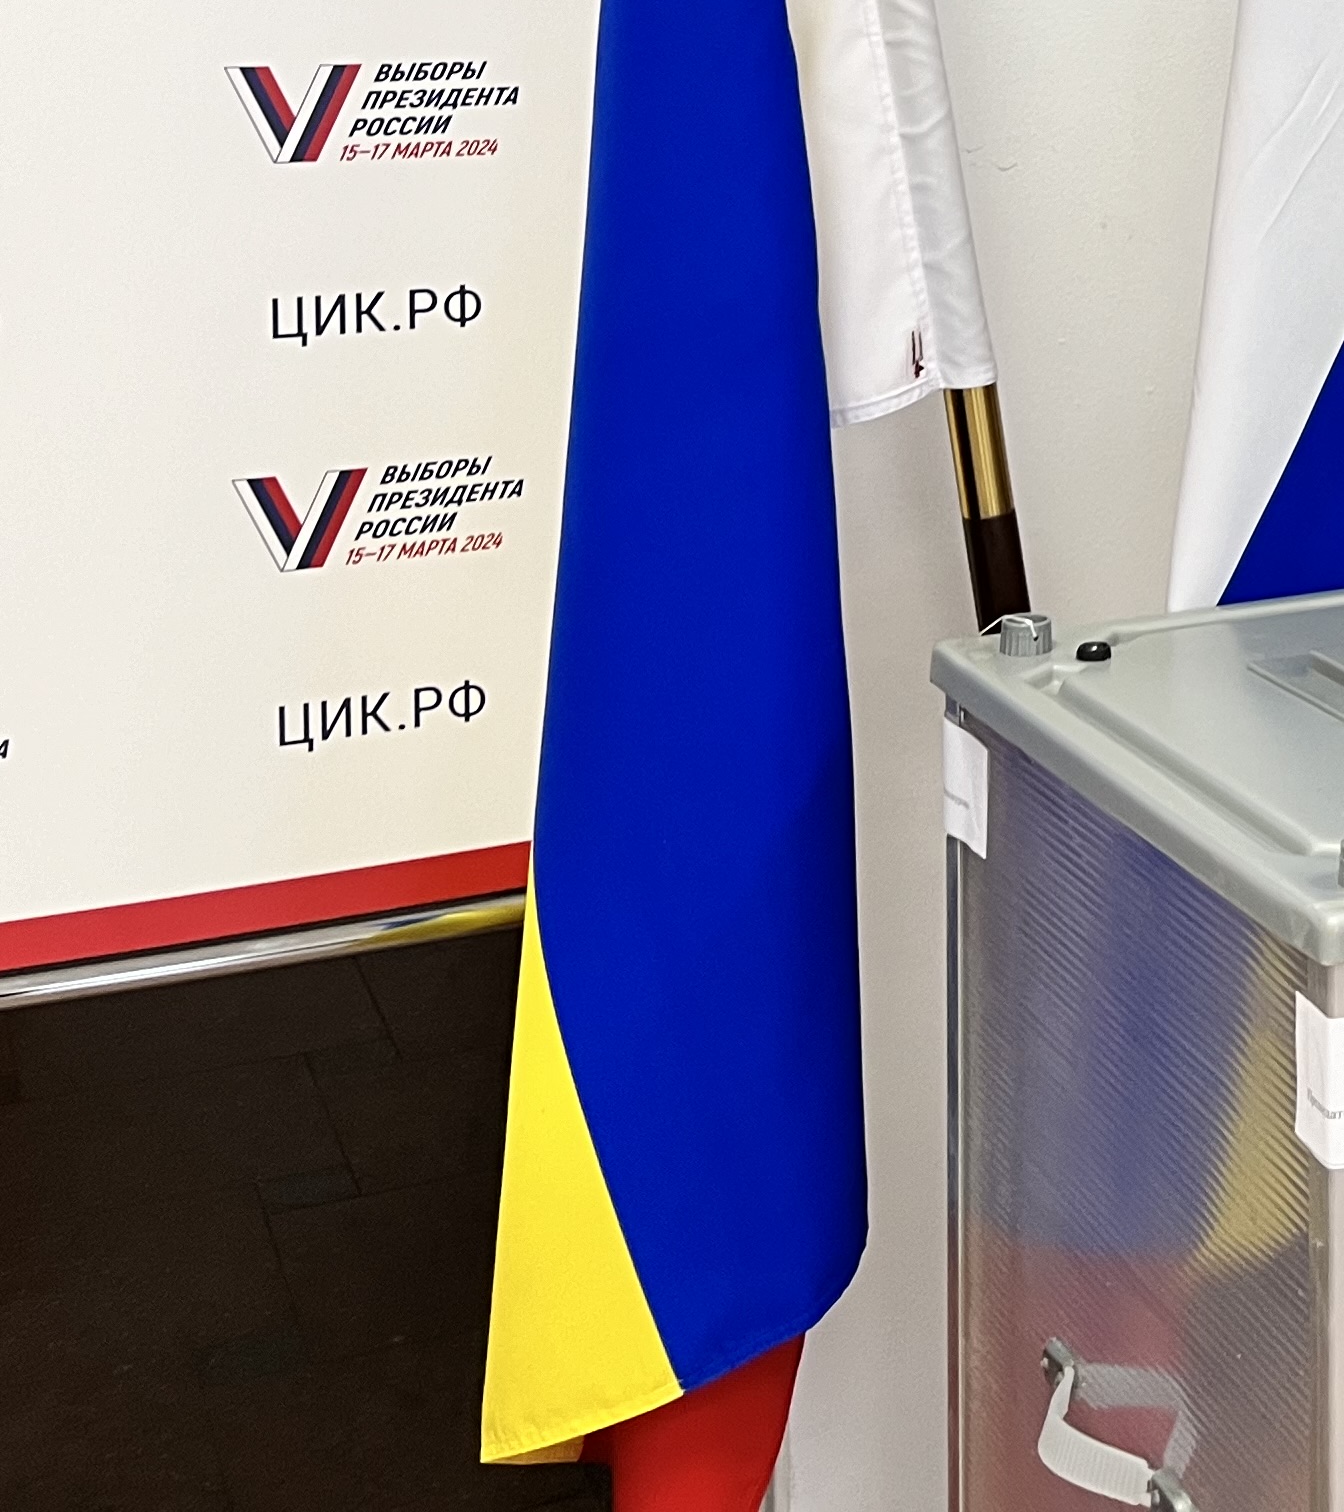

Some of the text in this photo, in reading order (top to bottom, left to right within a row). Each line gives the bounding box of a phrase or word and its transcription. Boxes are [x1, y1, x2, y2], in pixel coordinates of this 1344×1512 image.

[372, 60, 488, 83] ВЫБОРЫ
[360, 85, 520, 110] ПРЕЗИДЕНТА
[348, 114, 453, 138] РОССИИ
[391, 140, 451, 161] МАРТА
[455, 138, 499, 157] 2024
[271, 284, 483, 348] ЦИК.РФ
[379, 455, 493, 486] ВЫБОРЫ
[366, 478, 525, 514] ПРЕЗИДЕНТА
[353, 511, 458, 541] РОССИИ
[397, 537, 457, 561] МАРТА
[459, 531, 504, 554] 2024
[277, 679, 487, 754] ЦИК.РФ
